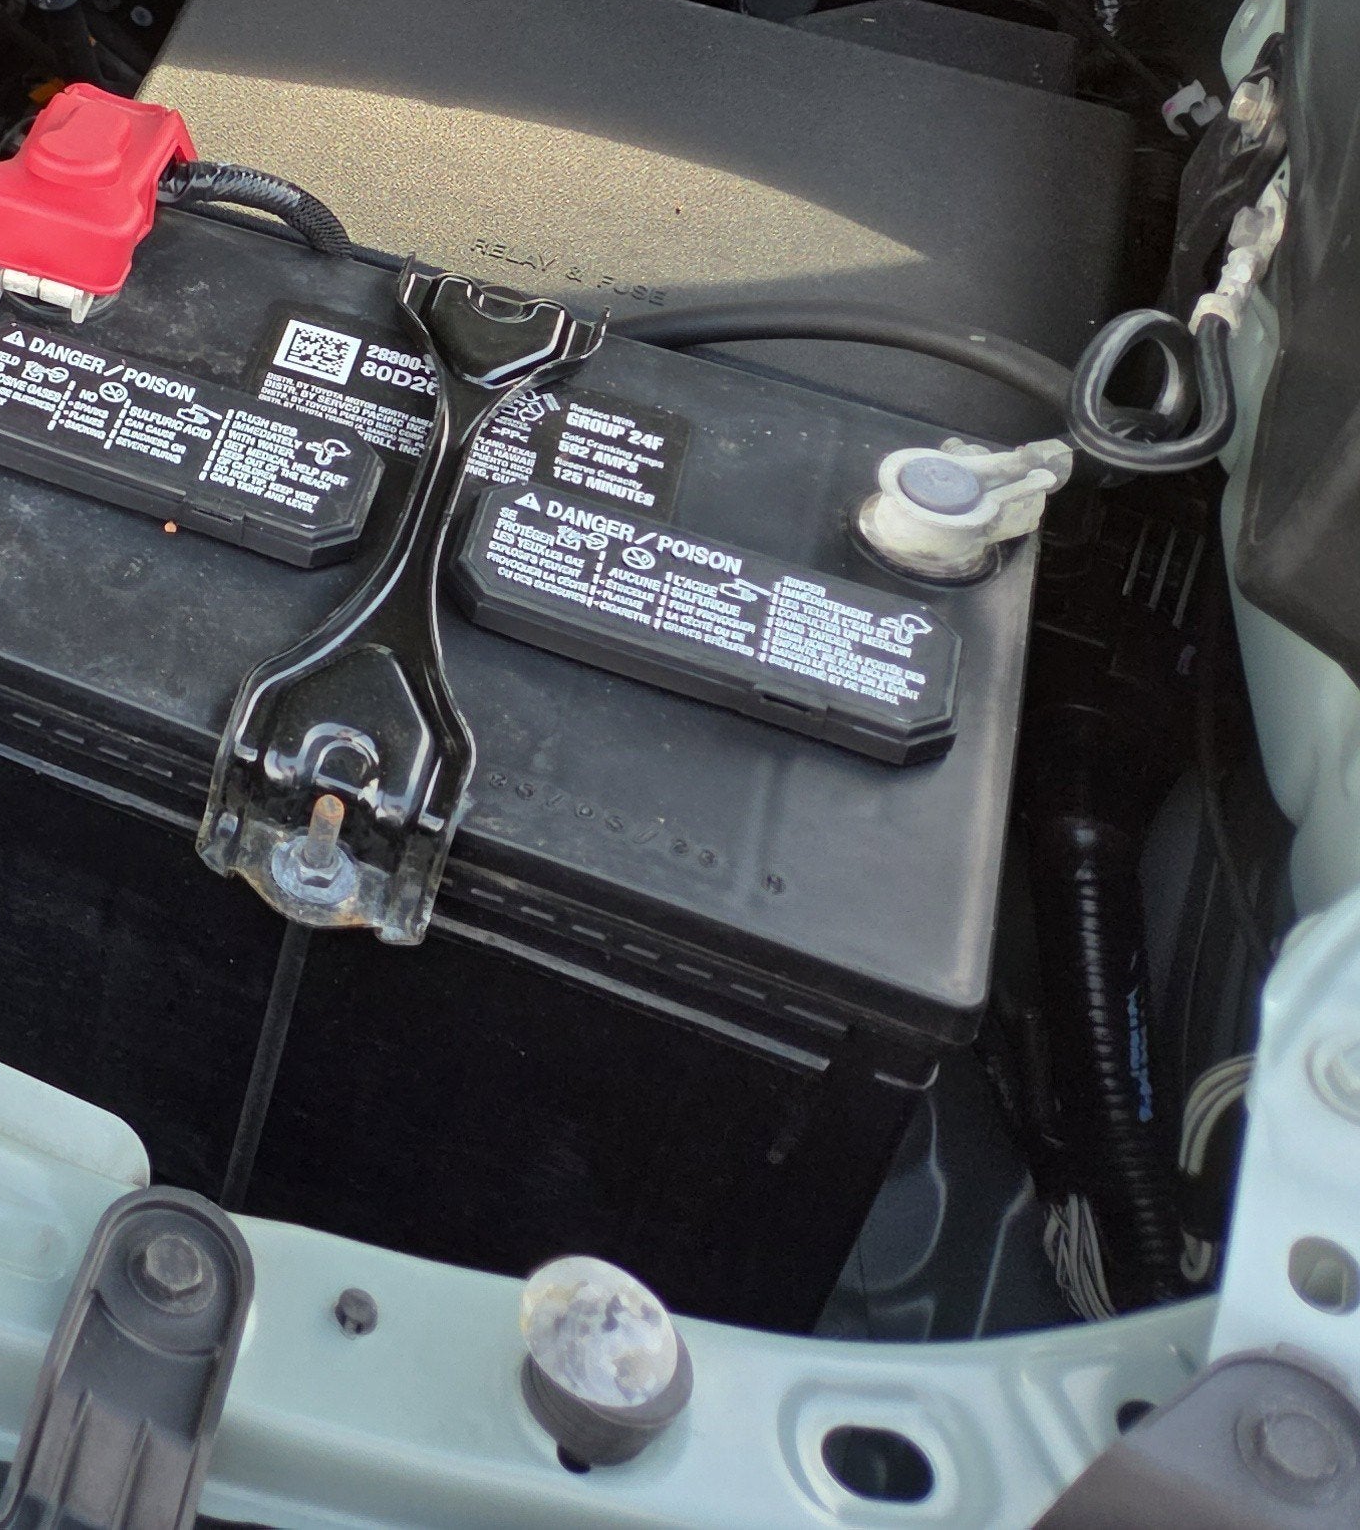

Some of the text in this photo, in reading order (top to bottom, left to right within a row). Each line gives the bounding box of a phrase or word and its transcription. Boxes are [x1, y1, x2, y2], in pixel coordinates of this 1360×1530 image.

[470, 239, 560, 271] RELAY
[597, 275, 667, 307] FUSE
[29, 337, 106, 374] DANGER
[122, 367, 196, 403] POISON
[366, 345, 435, 374] 28800-
[79, 389, 98, 402] NO
[311, 384, 343, 400] TOYOTA
[129, 406, 212, 440] SULFURIC ACID
[300, 389, 316, 401] BY
[362, 409, 404, 428] PACIFIC
[305, 400, 338, 416] TOYOTA
[339, 410, 374, 427] PUERTO
[124, 418, 144, 430] CAN
[228, 429, 256, 446] WITH
[231, 421, 303, 450] IMMEDIATELY
[566, 412, 664, 451] GROUP 24F
[223, 439, 349, 487] GET MEDICAL HELP FAST
[592, 451, 639, 474] AMPS
[553, 466, 656, 507] 125 MINUTES
[546, 500, 636, 542] DANGER
[656, 535, 742, 575] POISON
[608, 567, 662, 592] AUCUNE
